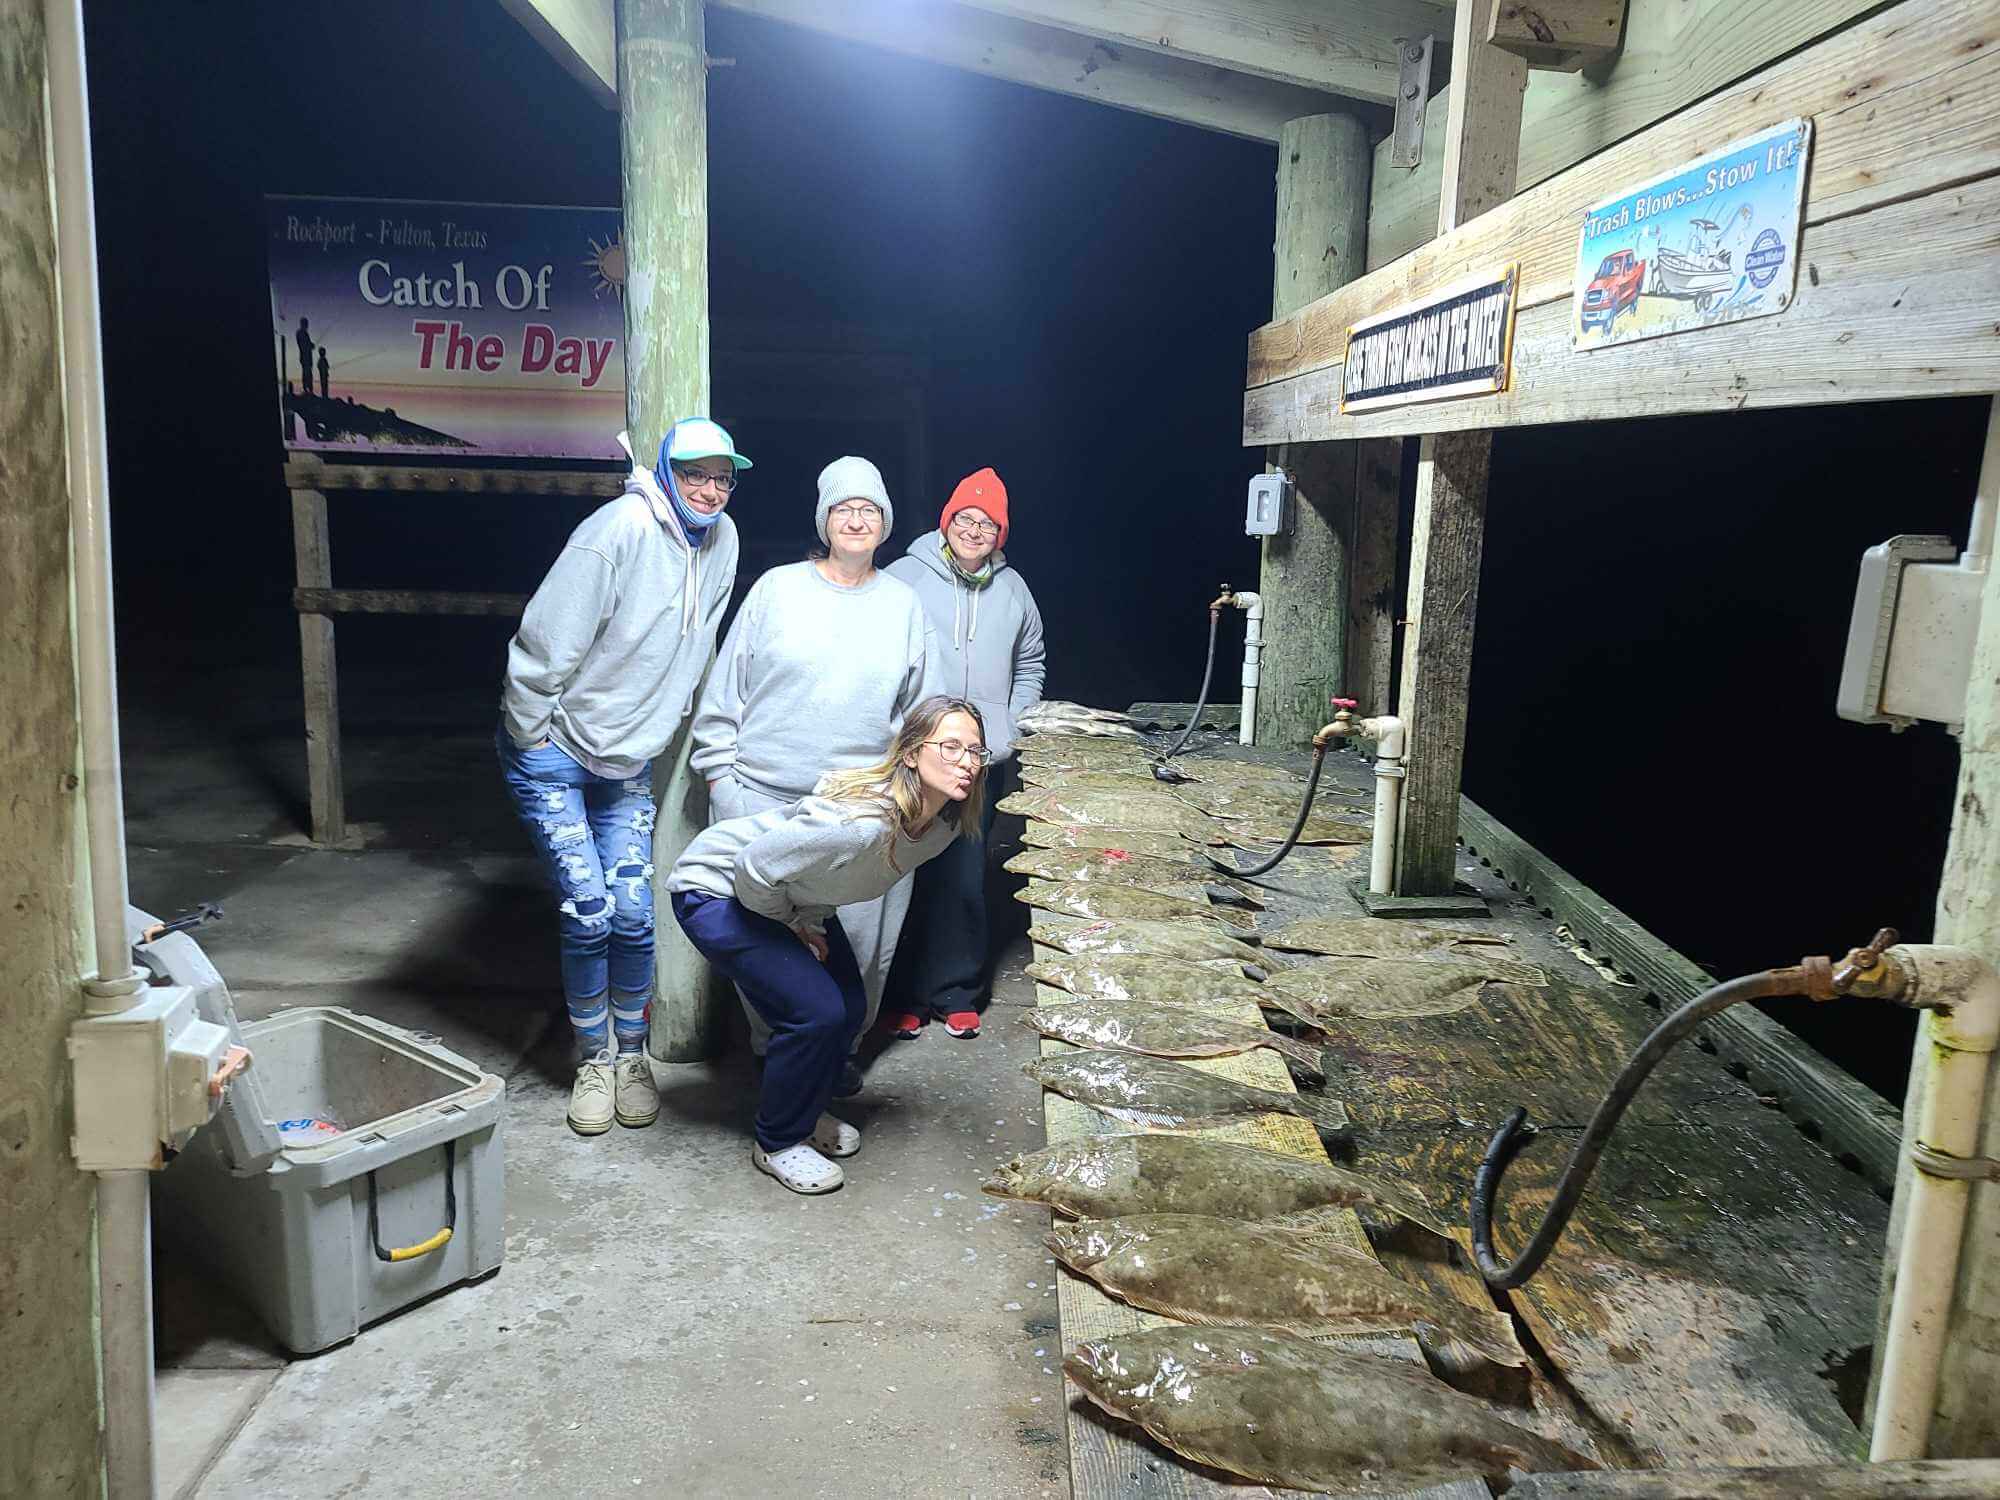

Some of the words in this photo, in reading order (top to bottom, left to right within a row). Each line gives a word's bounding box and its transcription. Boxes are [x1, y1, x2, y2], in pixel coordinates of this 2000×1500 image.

[287, 215, 355, 250] Rockport
[442, 221, 489, 249] Texas
[1588, 207, 1629, 239] Trash
[358, 259, 483, 309] Catch
[495, 265, 553, 310] Of
[412, 319, 504, 373] The
[520, 323, 617, 389] Day
[1386, 324, 1407, 386] FISH
[1403, 311, 1441, 384] CARCASS
[1447, 303, 1470, 374] THE
[1465, 291, 1505, 370] WATER
